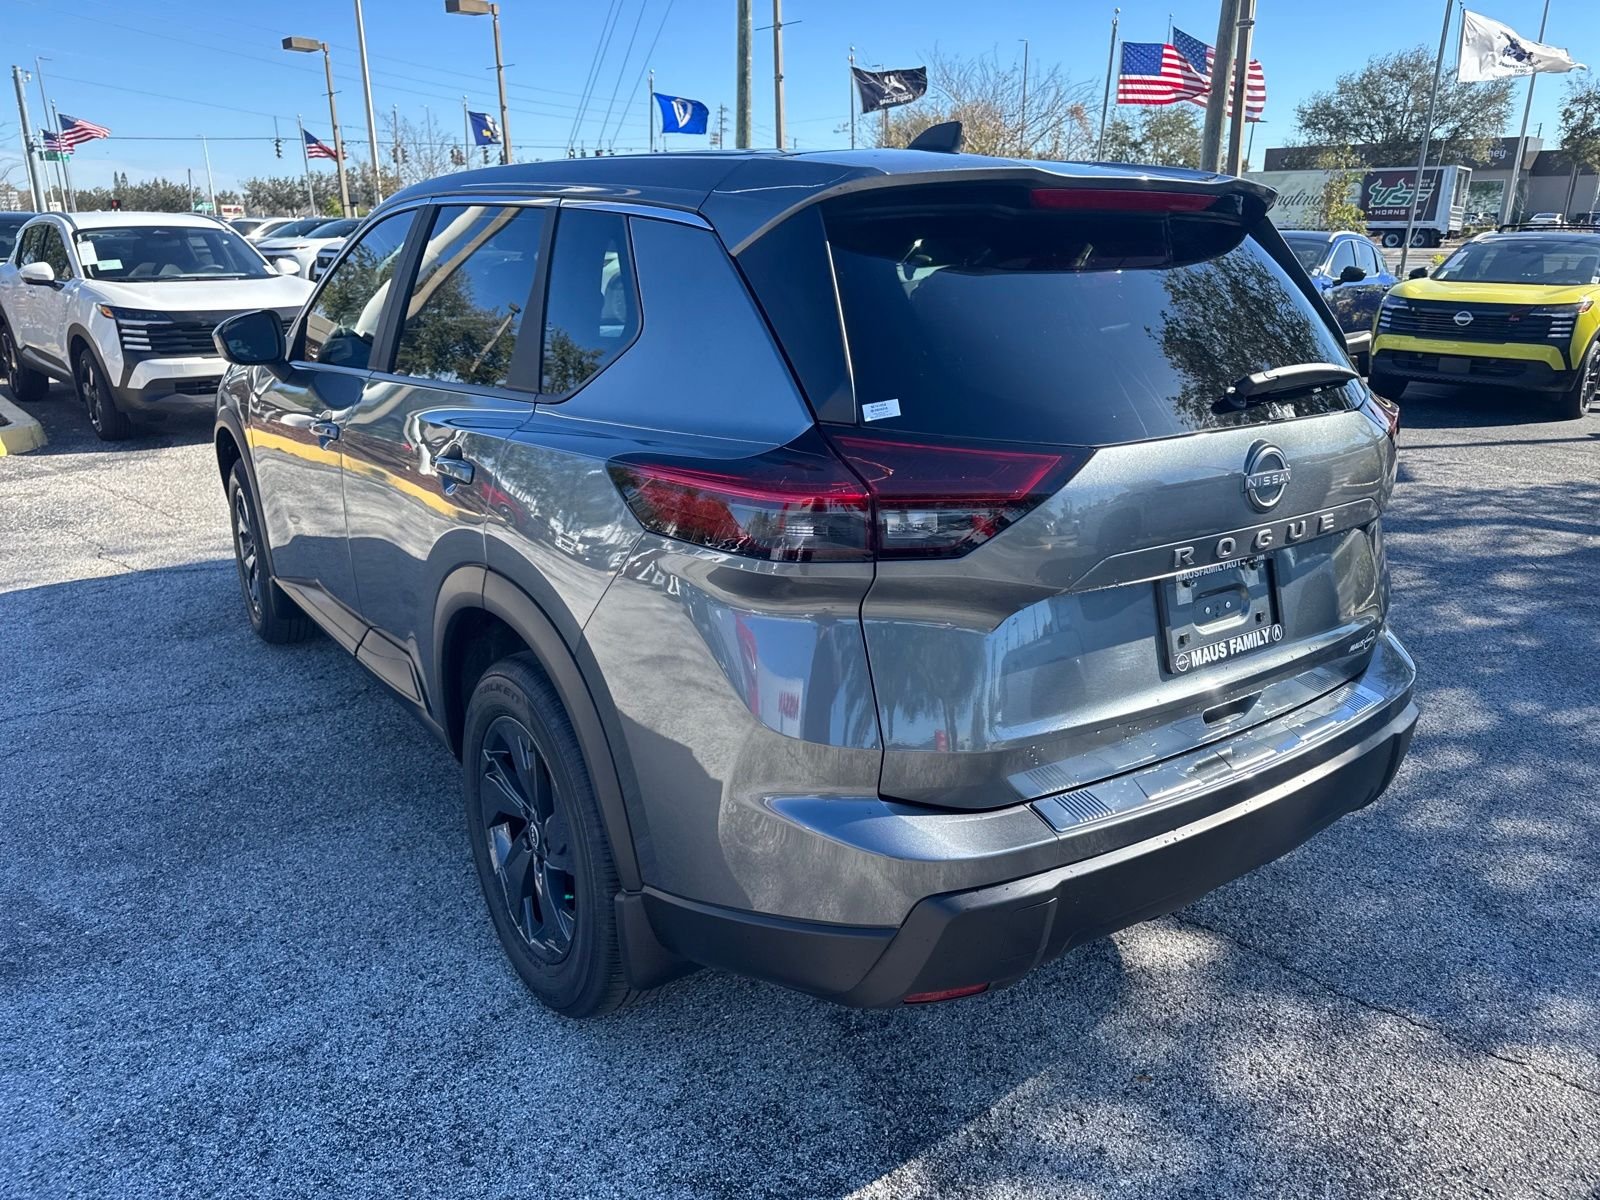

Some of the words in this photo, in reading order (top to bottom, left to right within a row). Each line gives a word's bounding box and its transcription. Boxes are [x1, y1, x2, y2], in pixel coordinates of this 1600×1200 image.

[1247, 472, 1290, 488] NISSAN
[1174, 513, 1335, 567] ROGUE
[1191, 642, 1228, 667] MAUS
[1229, 628, 1270, 656] FAMILY
